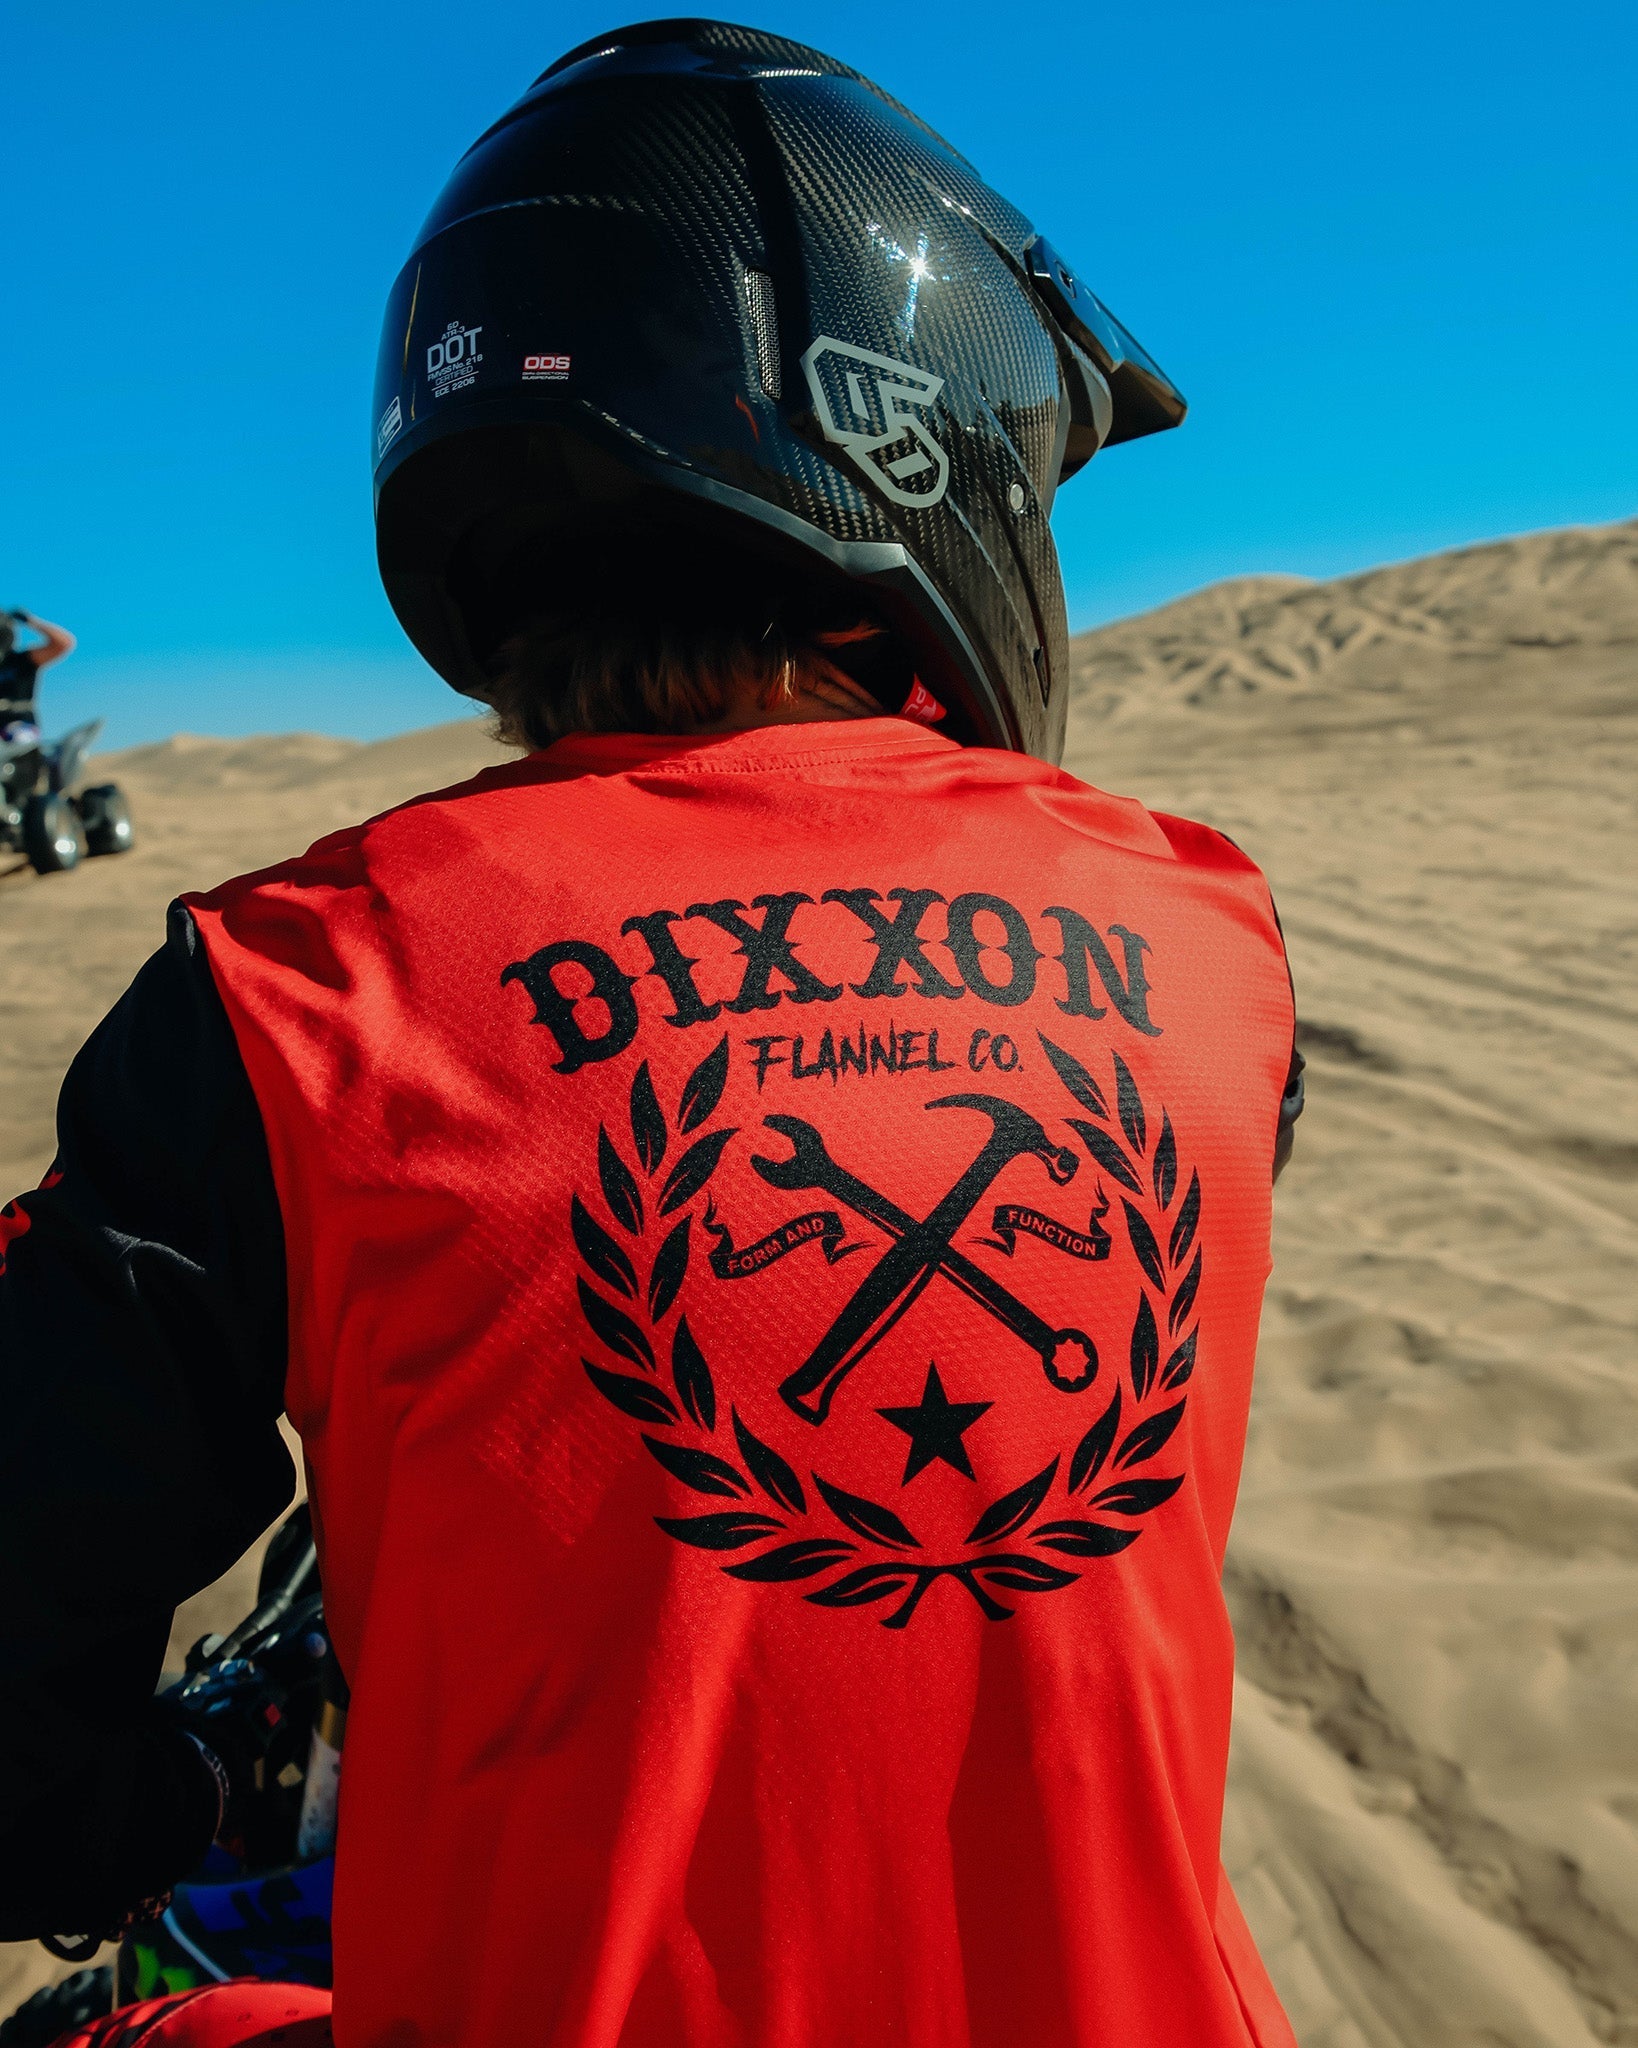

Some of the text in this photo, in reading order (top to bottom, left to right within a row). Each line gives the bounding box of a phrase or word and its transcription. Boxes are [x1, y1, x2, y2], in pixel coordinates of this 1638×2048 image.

[427, 326, 482, 374] DOT
[466, 354, 483, 366] 218
[524, 356, 571, 370] ODS
[434, 386, 450, 398] ECE
[435, 365, 474, 386] CERTIFIED
[500, 887, 1164, 1075] DIXXON
[743, 1018, 1025, 1094] FLANNEL CO.
[727, 1217, 825, 1275] FORM AND
[1007, 1209, 1097, 1256] FUNCTION
